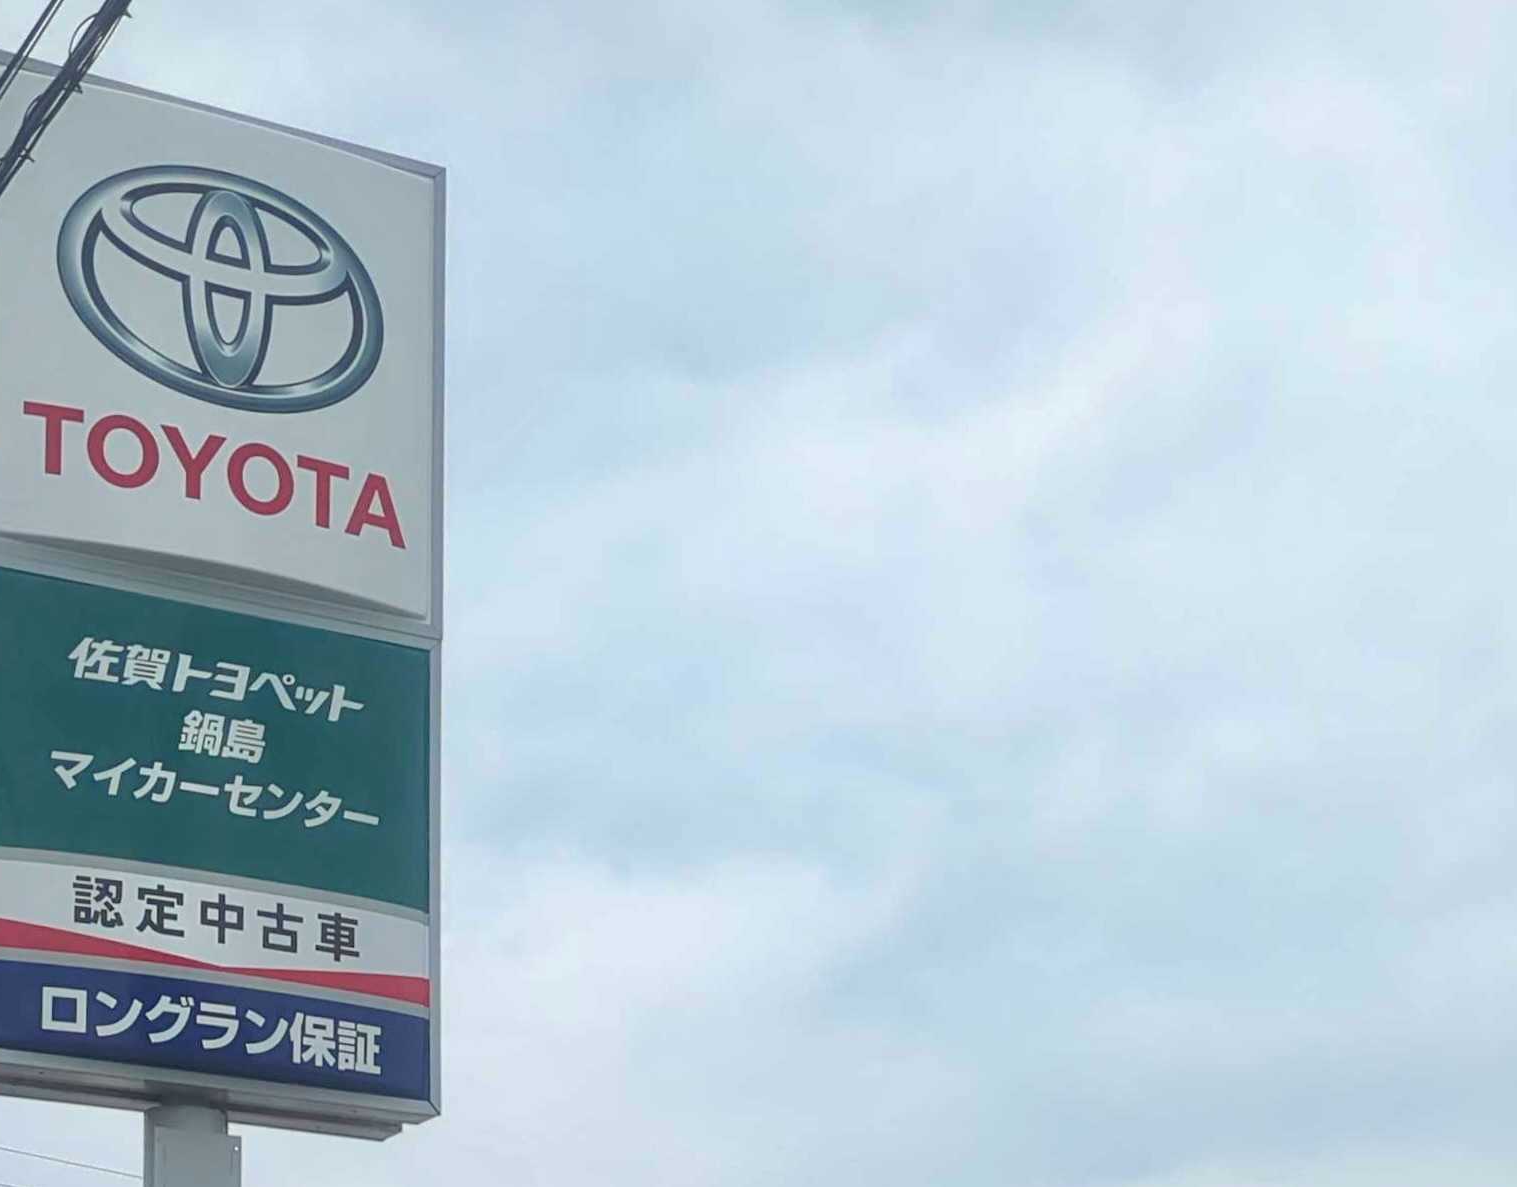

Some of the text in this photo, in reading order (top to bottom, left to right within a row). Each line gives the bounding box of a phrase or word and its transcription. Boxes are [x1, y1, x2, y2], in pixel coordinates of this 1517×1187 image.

[23, 401, 406, 550] TOYOTA
[68, 636, 365, 722] 佐賀トヨペット
[178, 710, 267, 764] 鍋島
[50, 750, 380, 828] マイカーセンター
[72, 875, 361, 962] 認定中古車
[41, 986, 382, 1075] ロングラン保証
